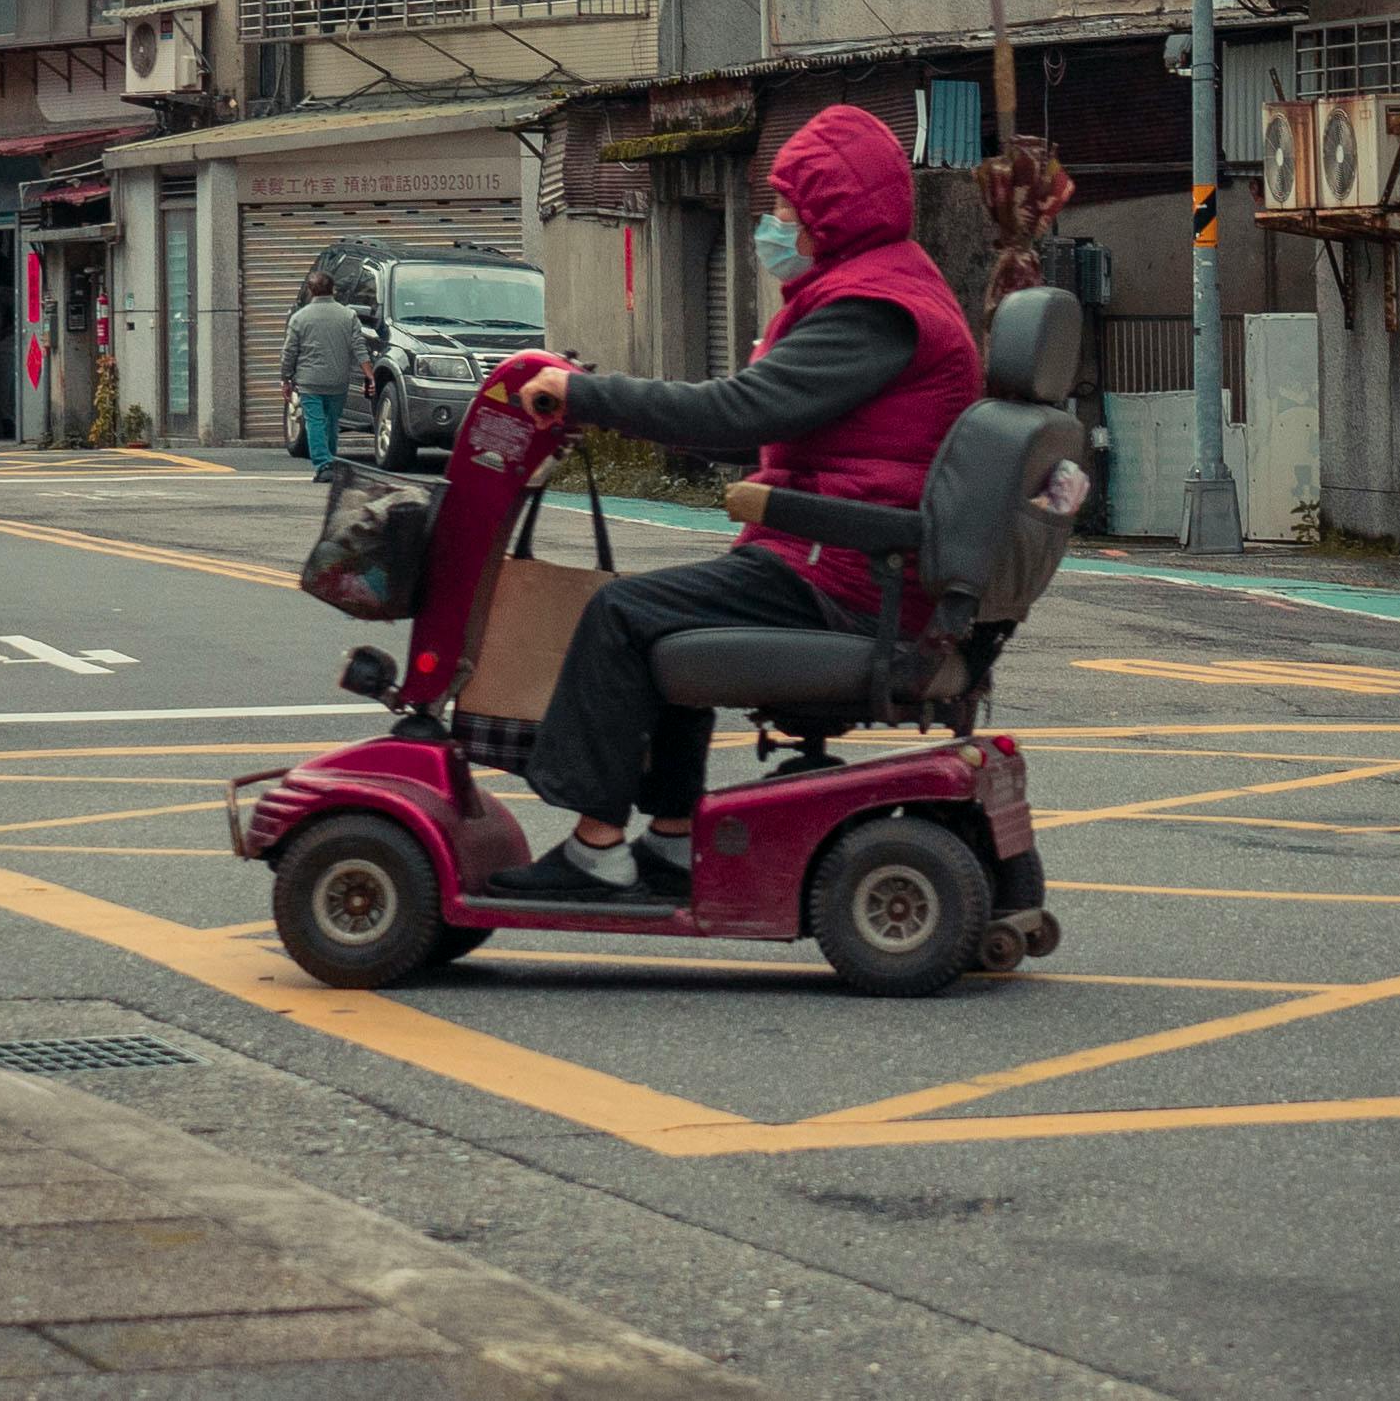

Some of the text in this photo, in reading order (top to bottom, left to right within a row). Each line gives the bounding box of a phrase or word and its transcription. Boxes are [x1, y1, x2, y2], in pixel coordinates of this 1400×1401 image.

[251, 173, 501, 196] 美髮工作室 預約電話0939230115
